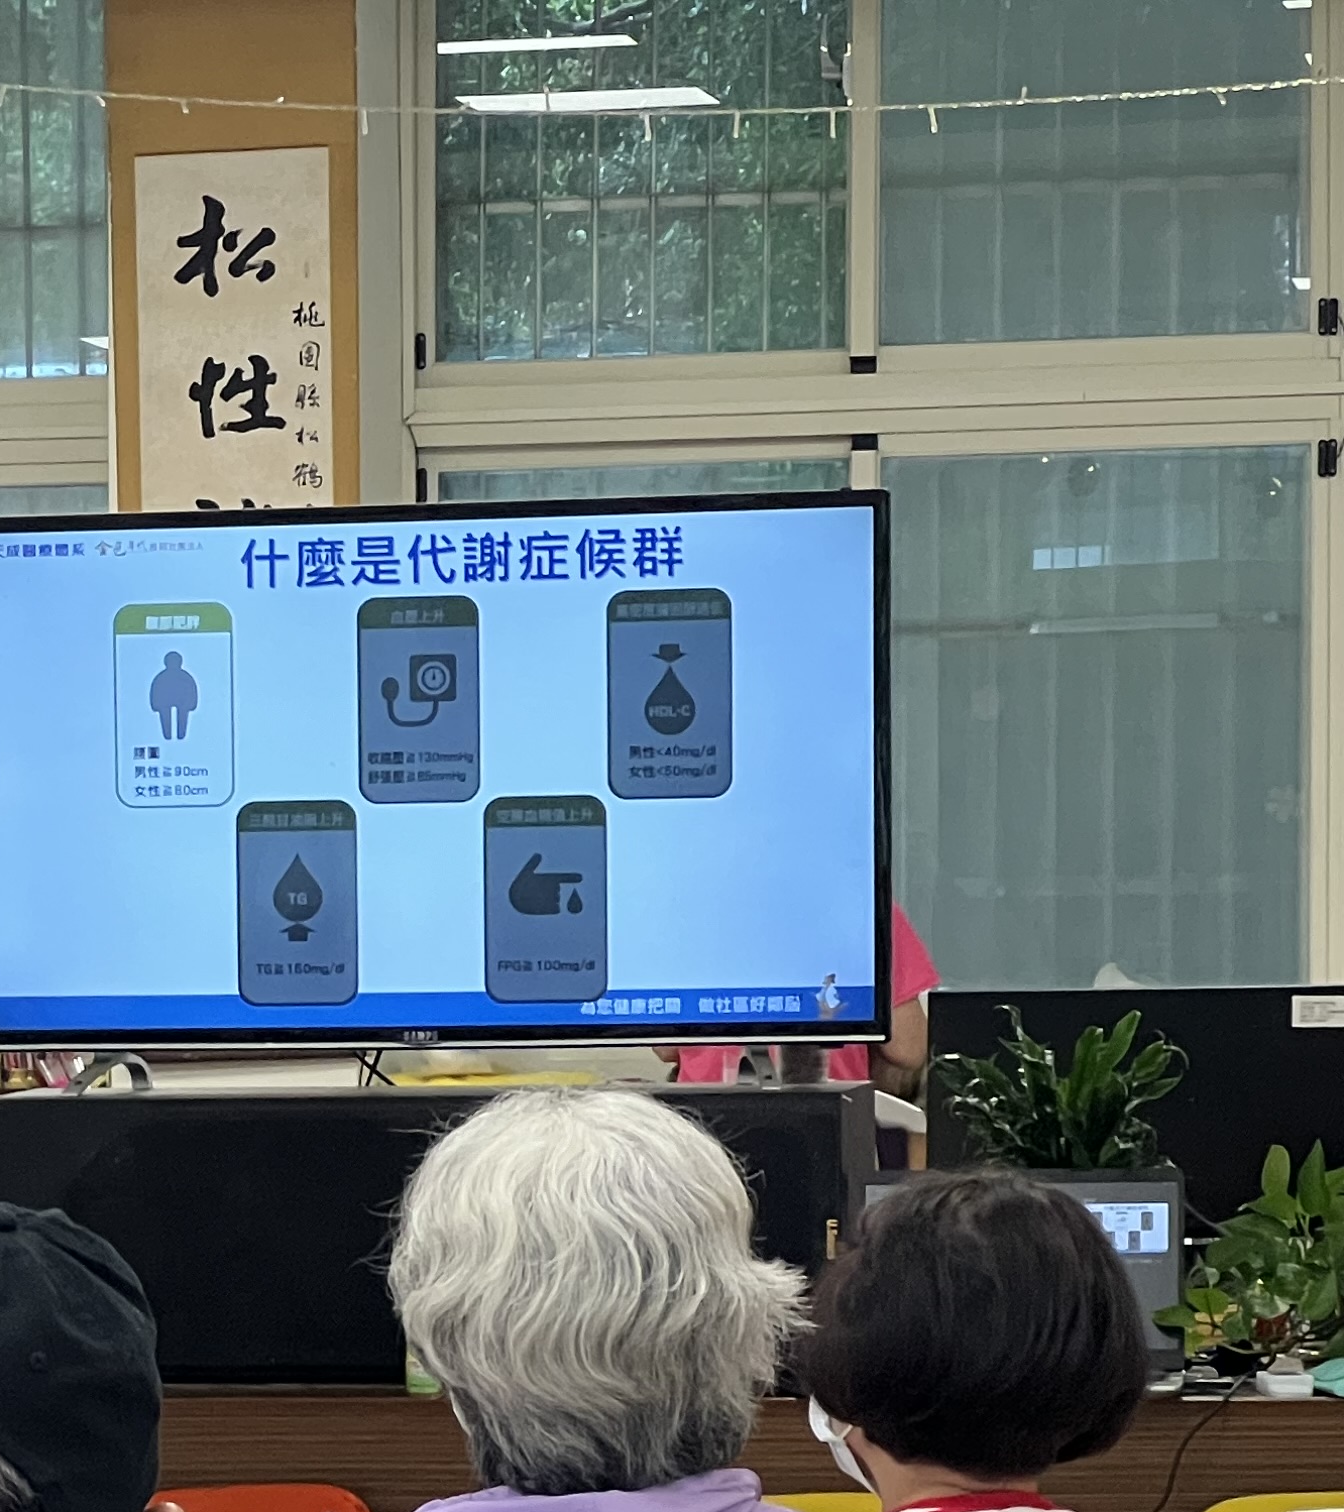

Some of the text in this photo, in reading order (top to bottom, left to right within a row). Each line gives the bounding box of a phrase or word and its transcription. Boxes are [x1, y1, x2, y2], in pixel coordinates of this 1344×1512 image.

[174, 195, 286, 508] 松性
[240, 525, 684, 590] 什麼是代謝症候群
[288, 892, 308, 906] TG
